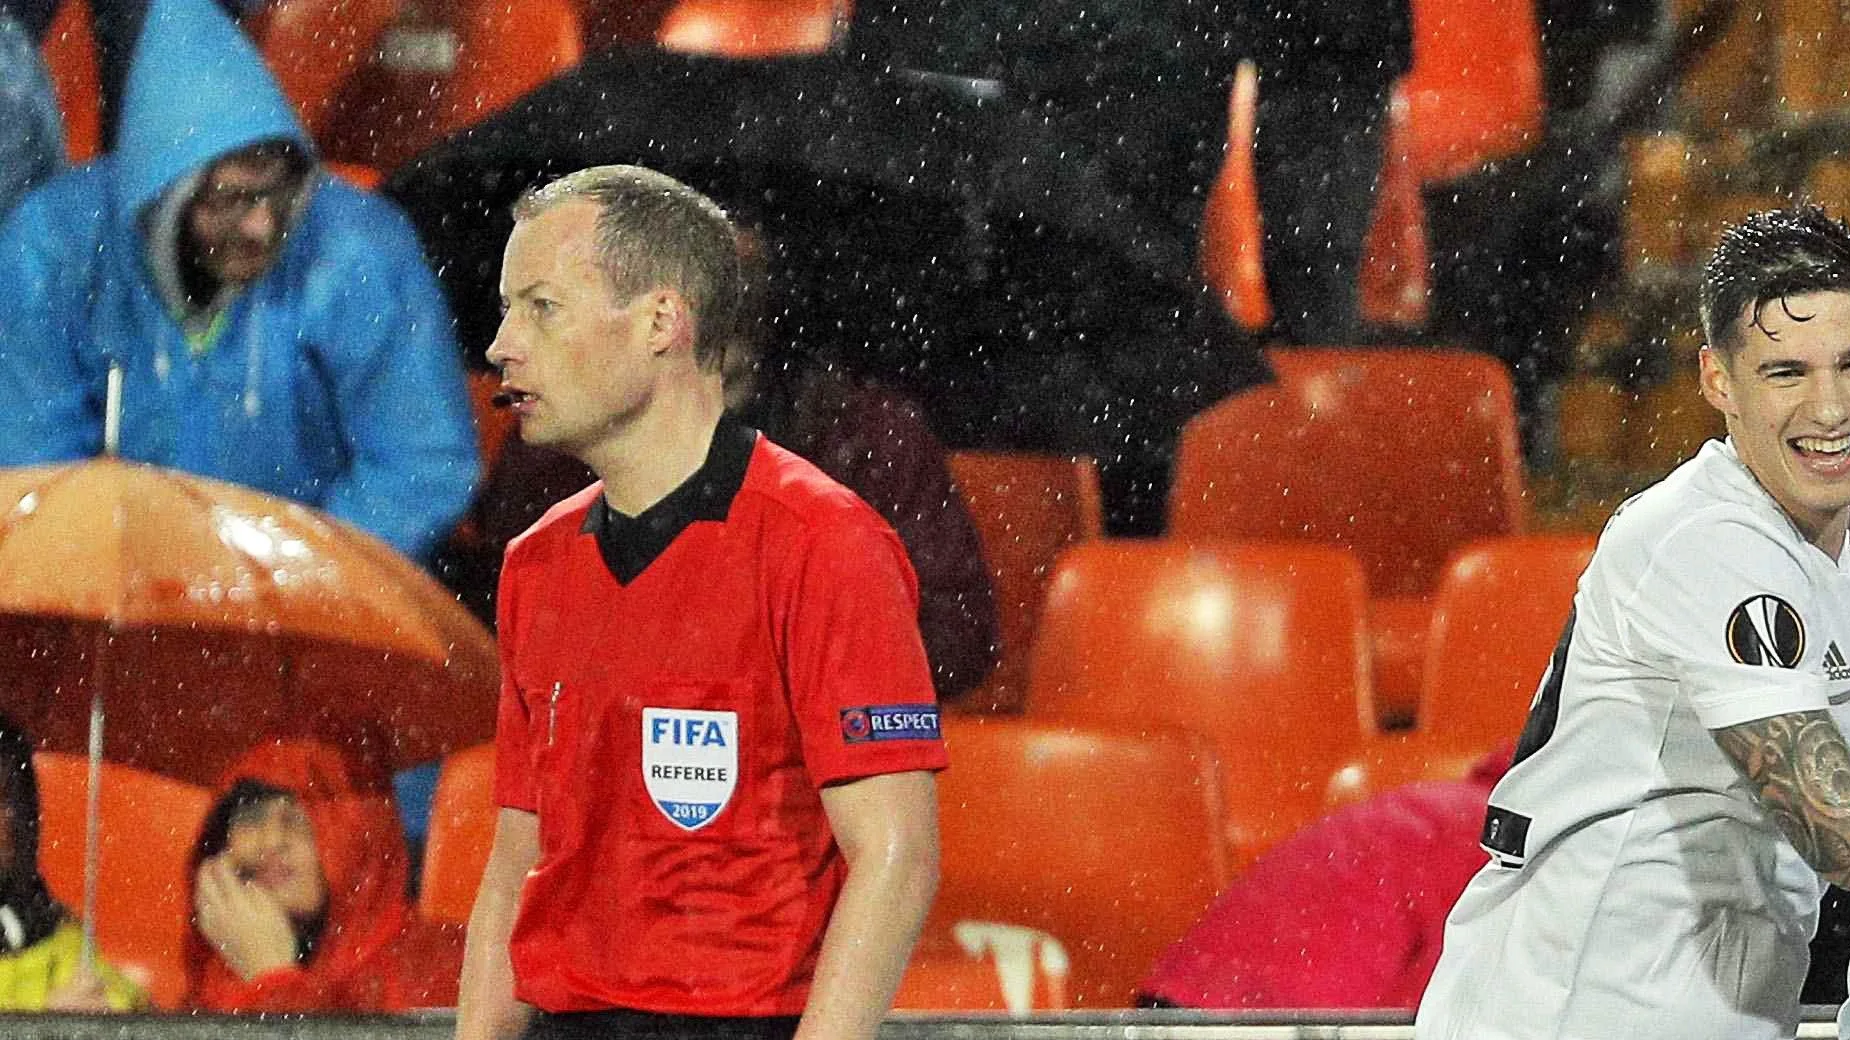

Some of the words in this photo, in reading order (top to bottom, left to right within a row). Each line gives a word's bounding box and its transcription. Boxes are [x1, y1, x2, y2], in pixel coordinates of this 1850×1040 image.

[871, 712, 938, 731] RESPECT
[651, 717, 727, 747] FIFA
[651, 764, 728, 782] REFEREE
[672, 804, 708, 819] 2019
